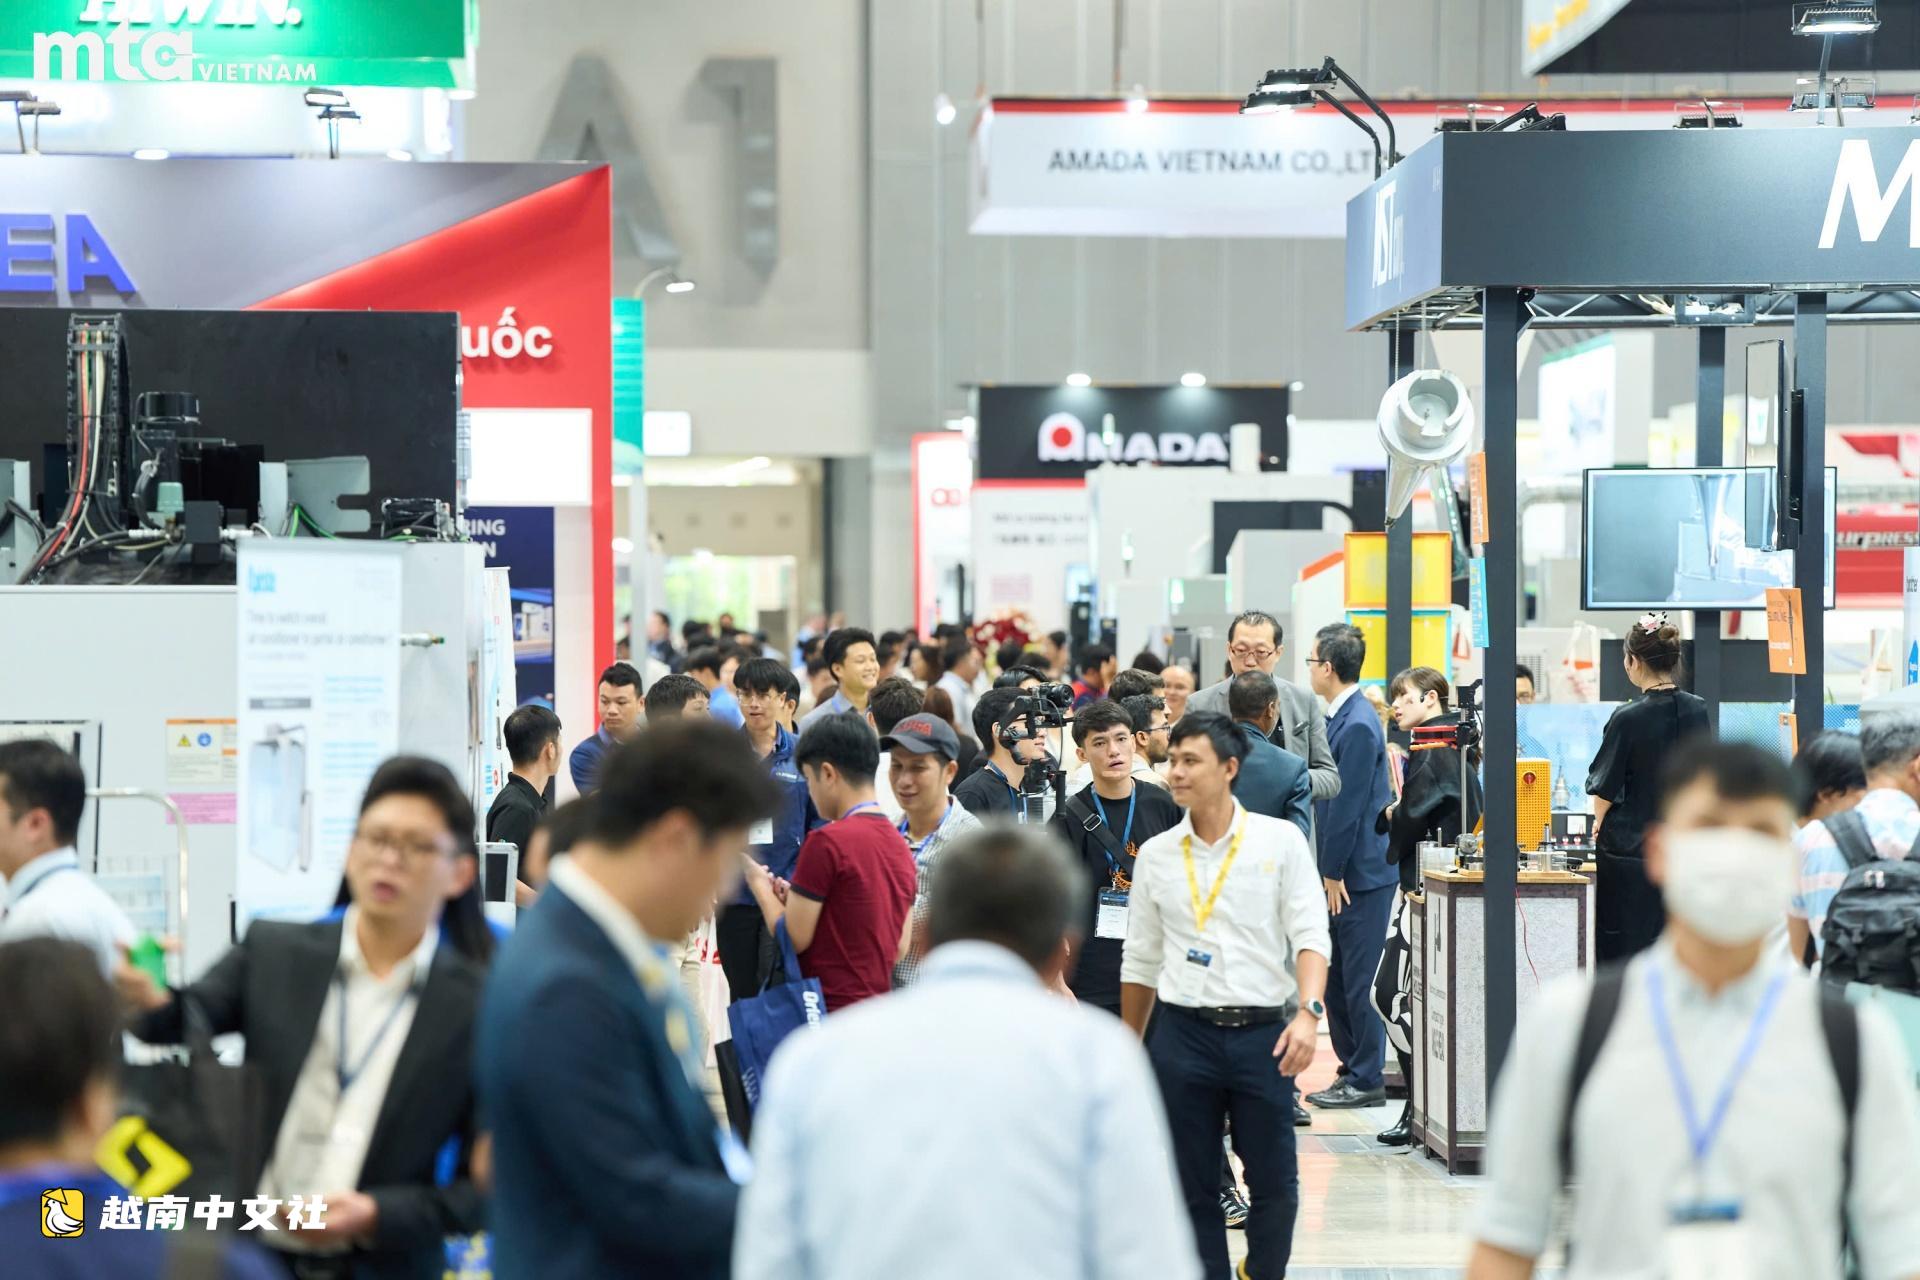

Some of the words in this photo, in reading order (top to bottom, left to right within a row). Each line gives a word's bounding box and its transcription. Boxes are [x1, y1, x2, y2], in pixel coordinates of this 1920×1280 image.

[1049, 149, 1149, 172] AMADA
[1157, 149, 1282, 172] VIETNAM
[0, 213, 137, 292] EA
